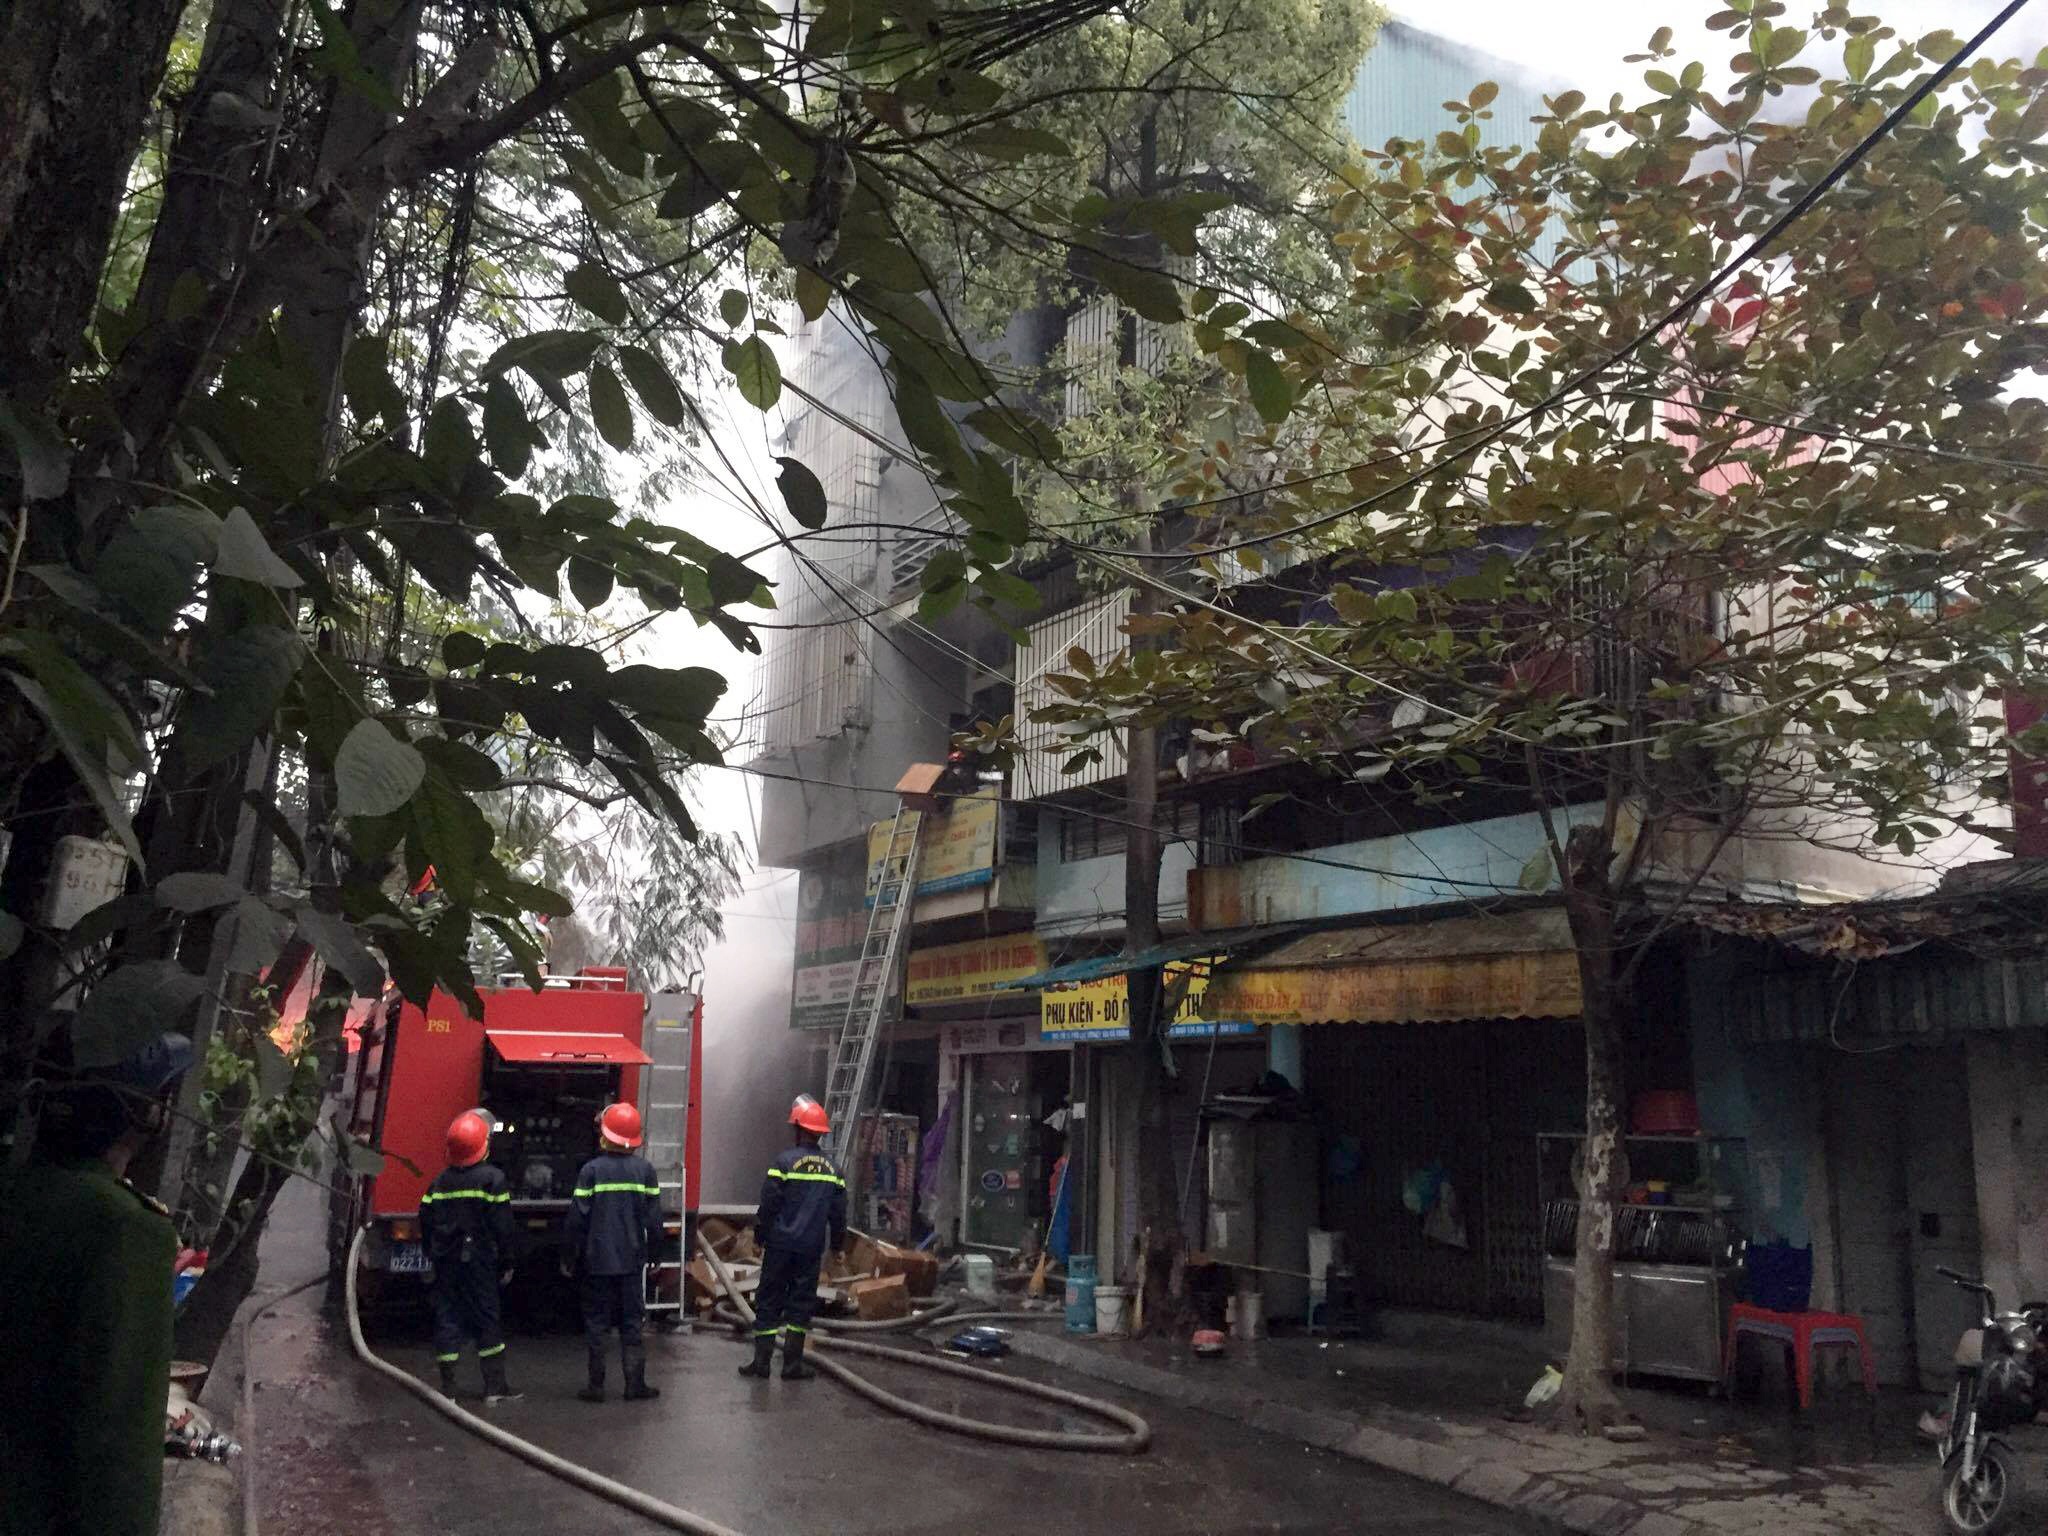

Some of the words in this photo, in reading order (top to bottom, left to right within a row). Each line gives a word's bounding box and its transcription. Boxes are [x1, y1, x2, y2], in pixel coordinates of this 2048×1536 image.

[1046, 1003, 1065, 1029] PHỤ
[1068, 996, 1093, 1028] KIỆN
[1104, 991, 1119, 1022] ĐỒ
